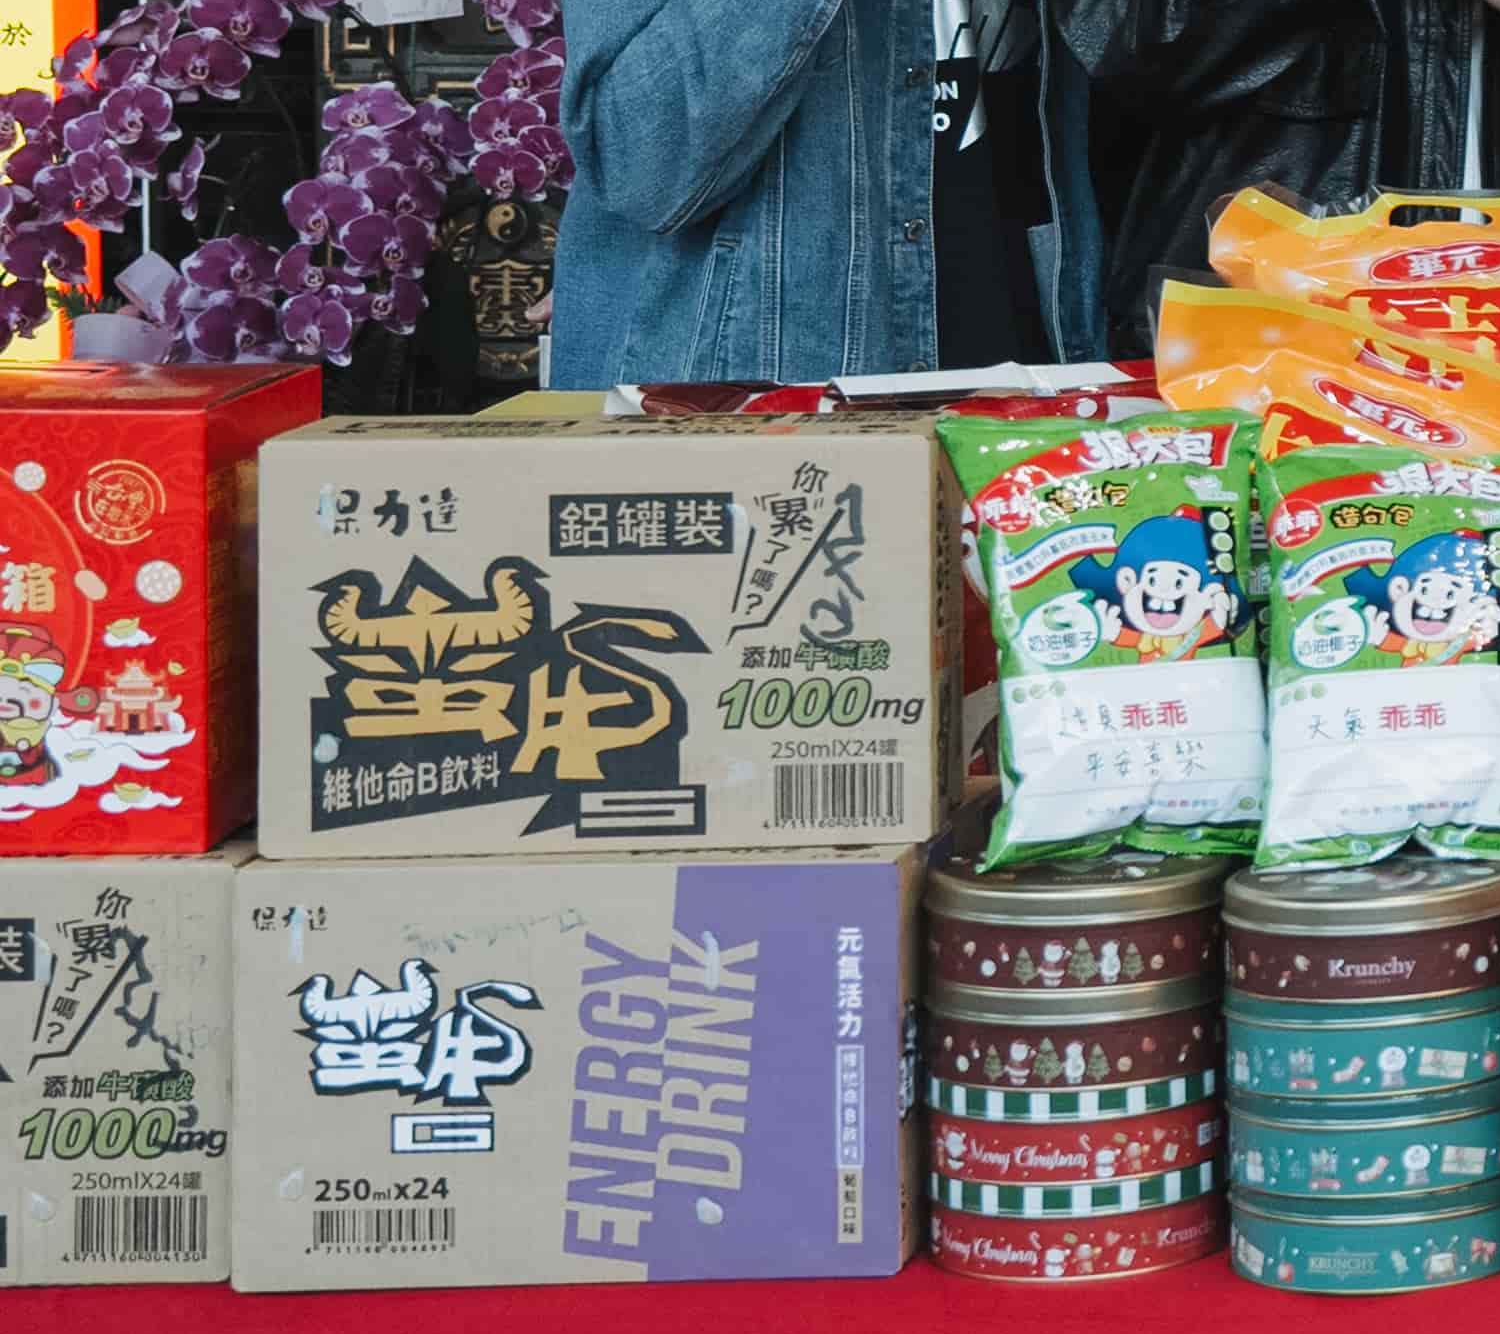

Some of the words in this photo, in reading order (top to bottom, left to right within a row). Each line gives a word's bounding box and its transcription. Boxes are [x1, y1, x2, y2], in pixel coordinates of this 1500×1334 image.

[1407, 248, 1486, 277] 華元
[558, 499, 726, 551] 鋁罐裝
[1330, 503, 1417, 531] 造句包
[716, 676, 925, 731] 1000mg
[321, 750, 502, 815] 維他命B飲料
[835, 926, 864, 1040] 元氣活力
[1327, 956, 1417, 980] Krunchy
[656, 938, 761, 1192] DRINK
[563, 933, 669, 1271] ENERGY
[1014, 1143, 1088, 1170] Christmas
